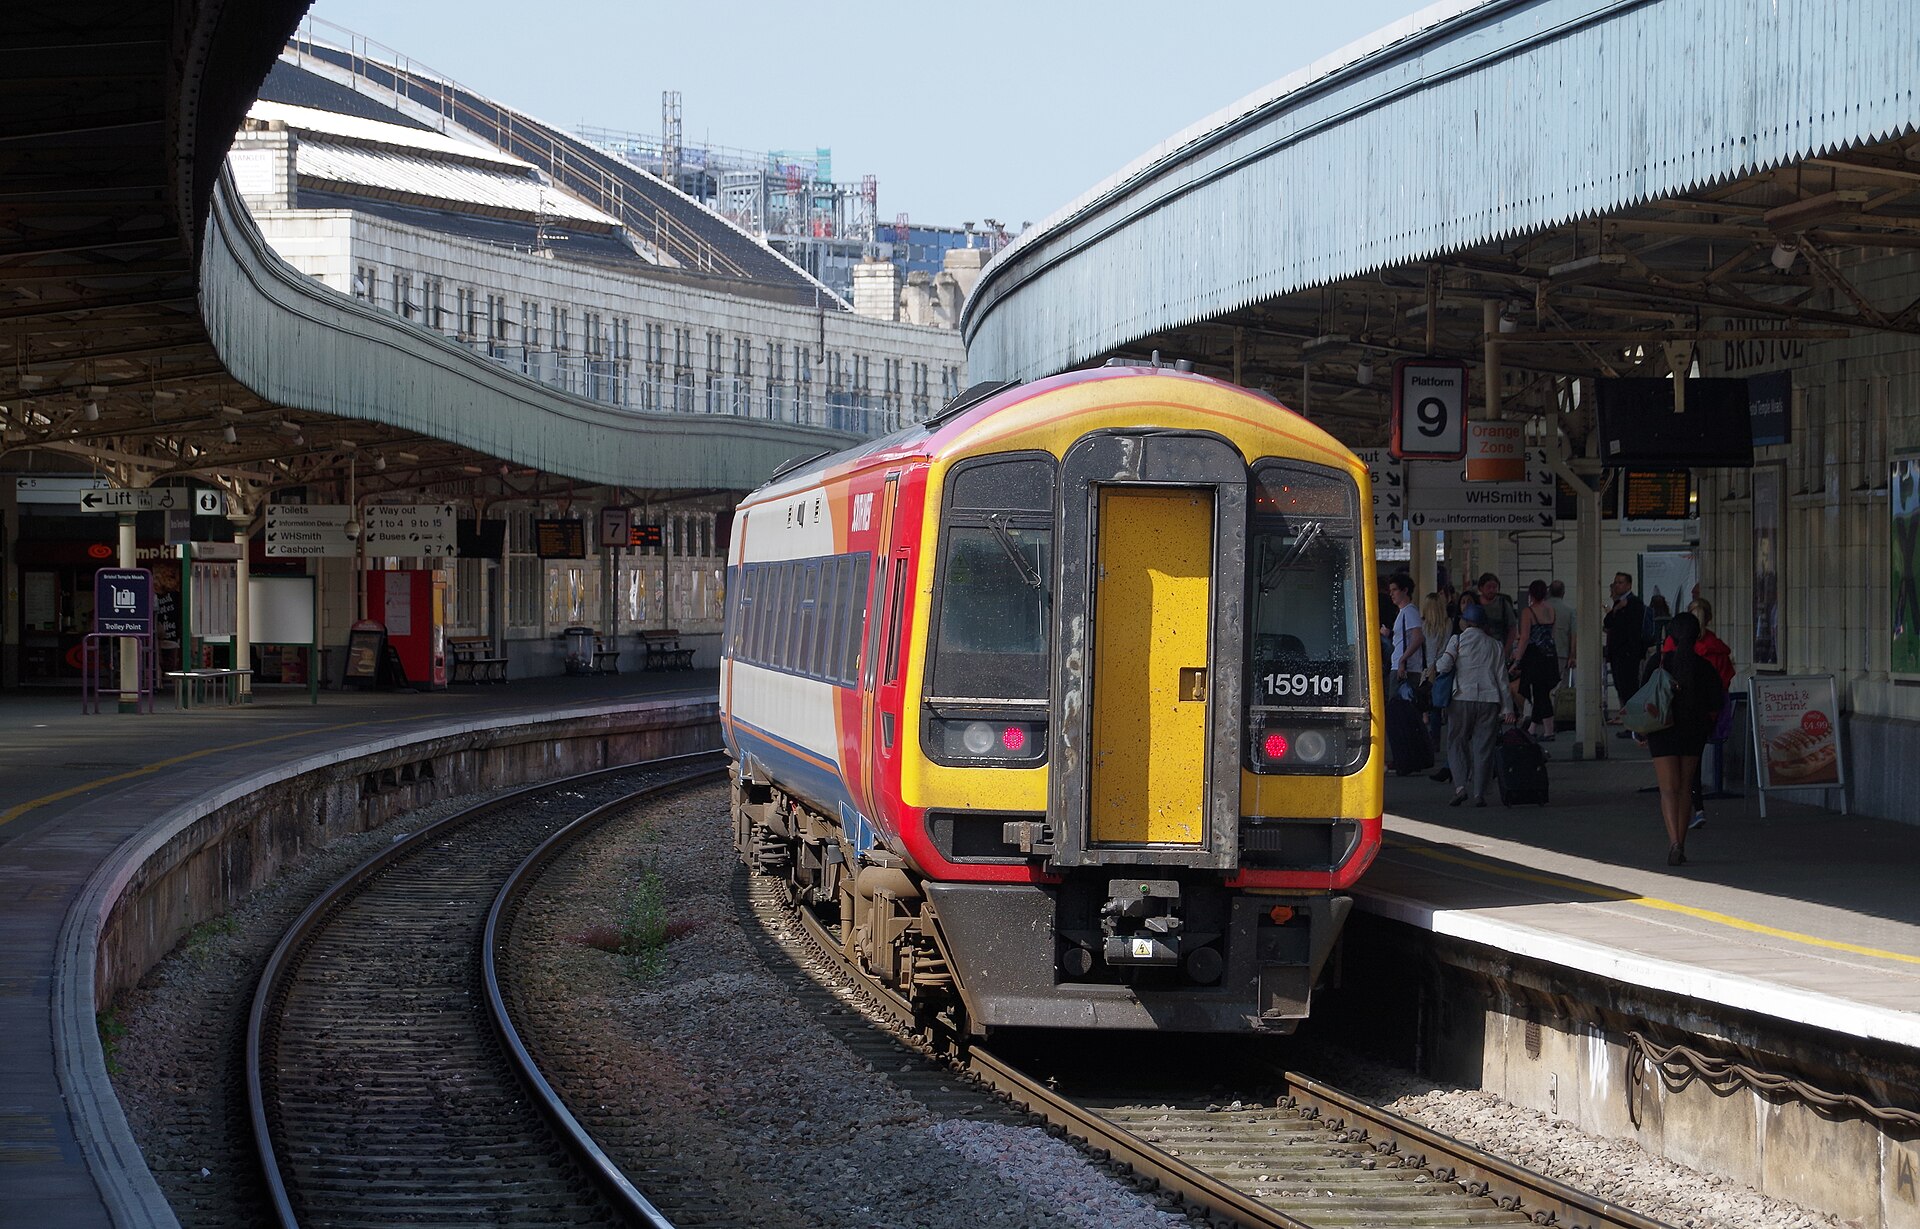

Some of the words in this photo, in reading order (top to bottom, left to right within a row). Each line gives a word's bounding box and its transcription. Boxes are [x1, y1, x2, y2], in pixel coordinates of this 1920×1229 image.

[1411, 376, 1454, 387] Platform
[1417, 397, 1448, 438] 9
[1472, 425, 1520, 439] Orange
[1480, 441, 1514, 454] Zone
[106, 492, 131, 505] Lift
[1466, 491, 1532, 503] WHSmith
[280, 506, 309, 514] Toilets
[379, 506, 399, 515] Way
[434, 506, 440, 514] 7
[433, 519, 442, 527] 15
[1447, 513, 1505, 523] Information
[1508, 513, 1534, 523] Desk
[609, 522, 620, 537] 7
[280, 532, 322, 540] WHSmith
[280, 545, 325, 554] Cashpoint
[436, 545, 442, 553] 7
[105, 623, 124, 631] Trolley
[1263, 673, 1343, 696] 159101
[1764, 690, 1799, 702] Panini
[1765, 703, 1772, 712] a
[1775, 700, 1807, 712] Drink
